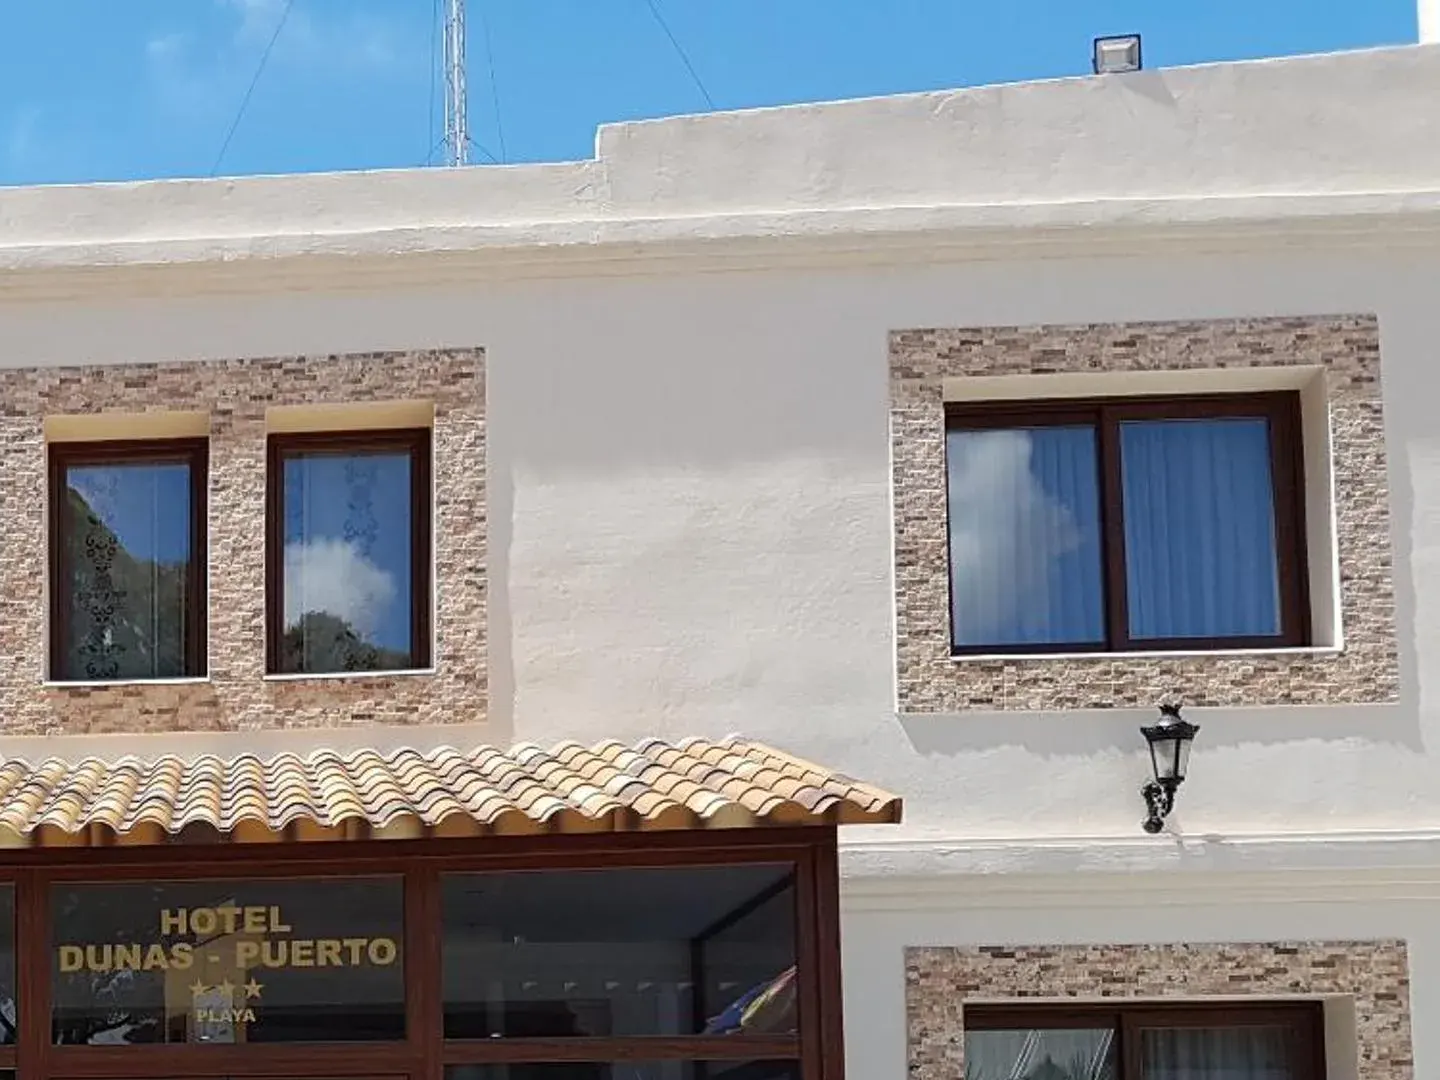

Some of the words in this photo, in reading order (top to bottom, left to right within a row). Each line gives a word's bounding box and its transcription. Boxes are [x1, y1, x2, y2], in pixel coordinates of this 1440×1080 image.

[161, 905, 292, 935] HOTEL
[59, 942, 195, 973] DUNAS
[235, 938, 398, 969] PUERTO
[196, 1008, 257, 1023] PLAYA
